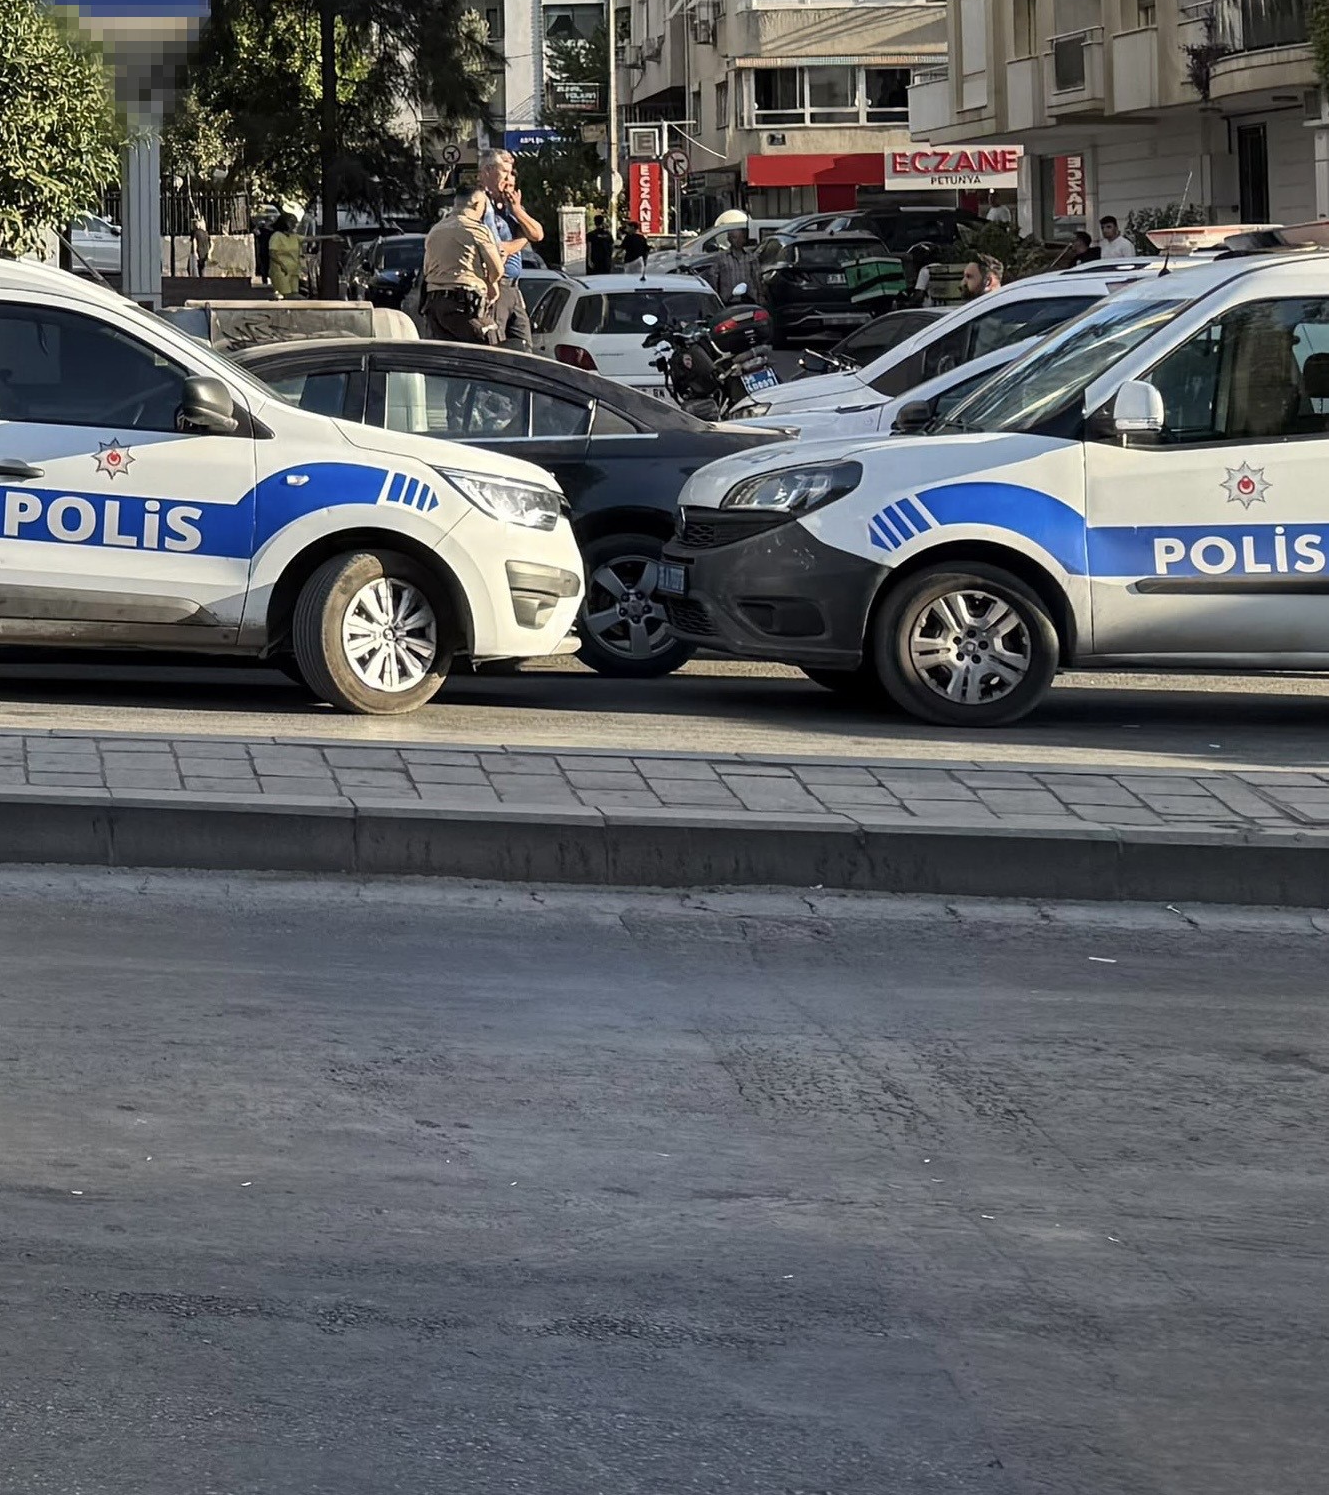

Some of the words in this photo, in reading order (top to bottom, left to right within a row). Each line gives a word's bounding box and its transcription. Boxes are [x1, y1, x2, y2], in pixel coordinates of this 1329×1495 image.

[893, 150, 1018, 174] ECZANE
[930, 175, 981, 185] PETUNYA
[639, 164, 652, 233] ECZANE
